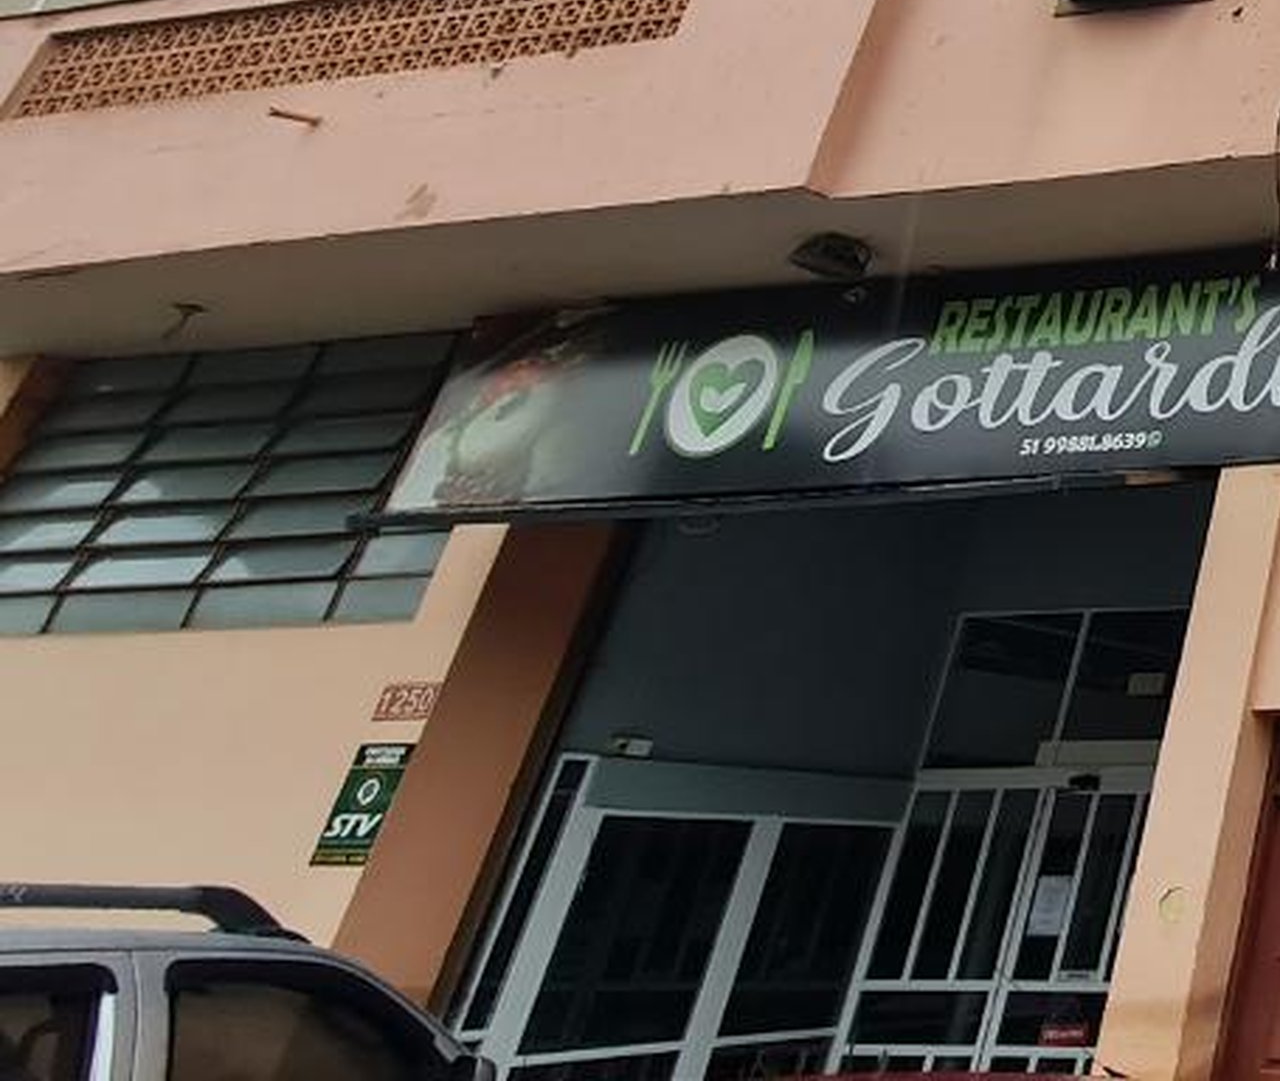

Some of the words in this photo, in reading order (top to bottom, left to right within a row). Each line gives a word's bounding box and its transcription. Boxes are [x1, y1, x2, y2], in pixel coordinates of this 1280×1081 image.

[930, 276, 1261, 355] RESTAURANT'S
[1020, 439, 1039, 455] 51
[380, 687, 434, 714] 1250
[323, 813, 384, 837] STV
